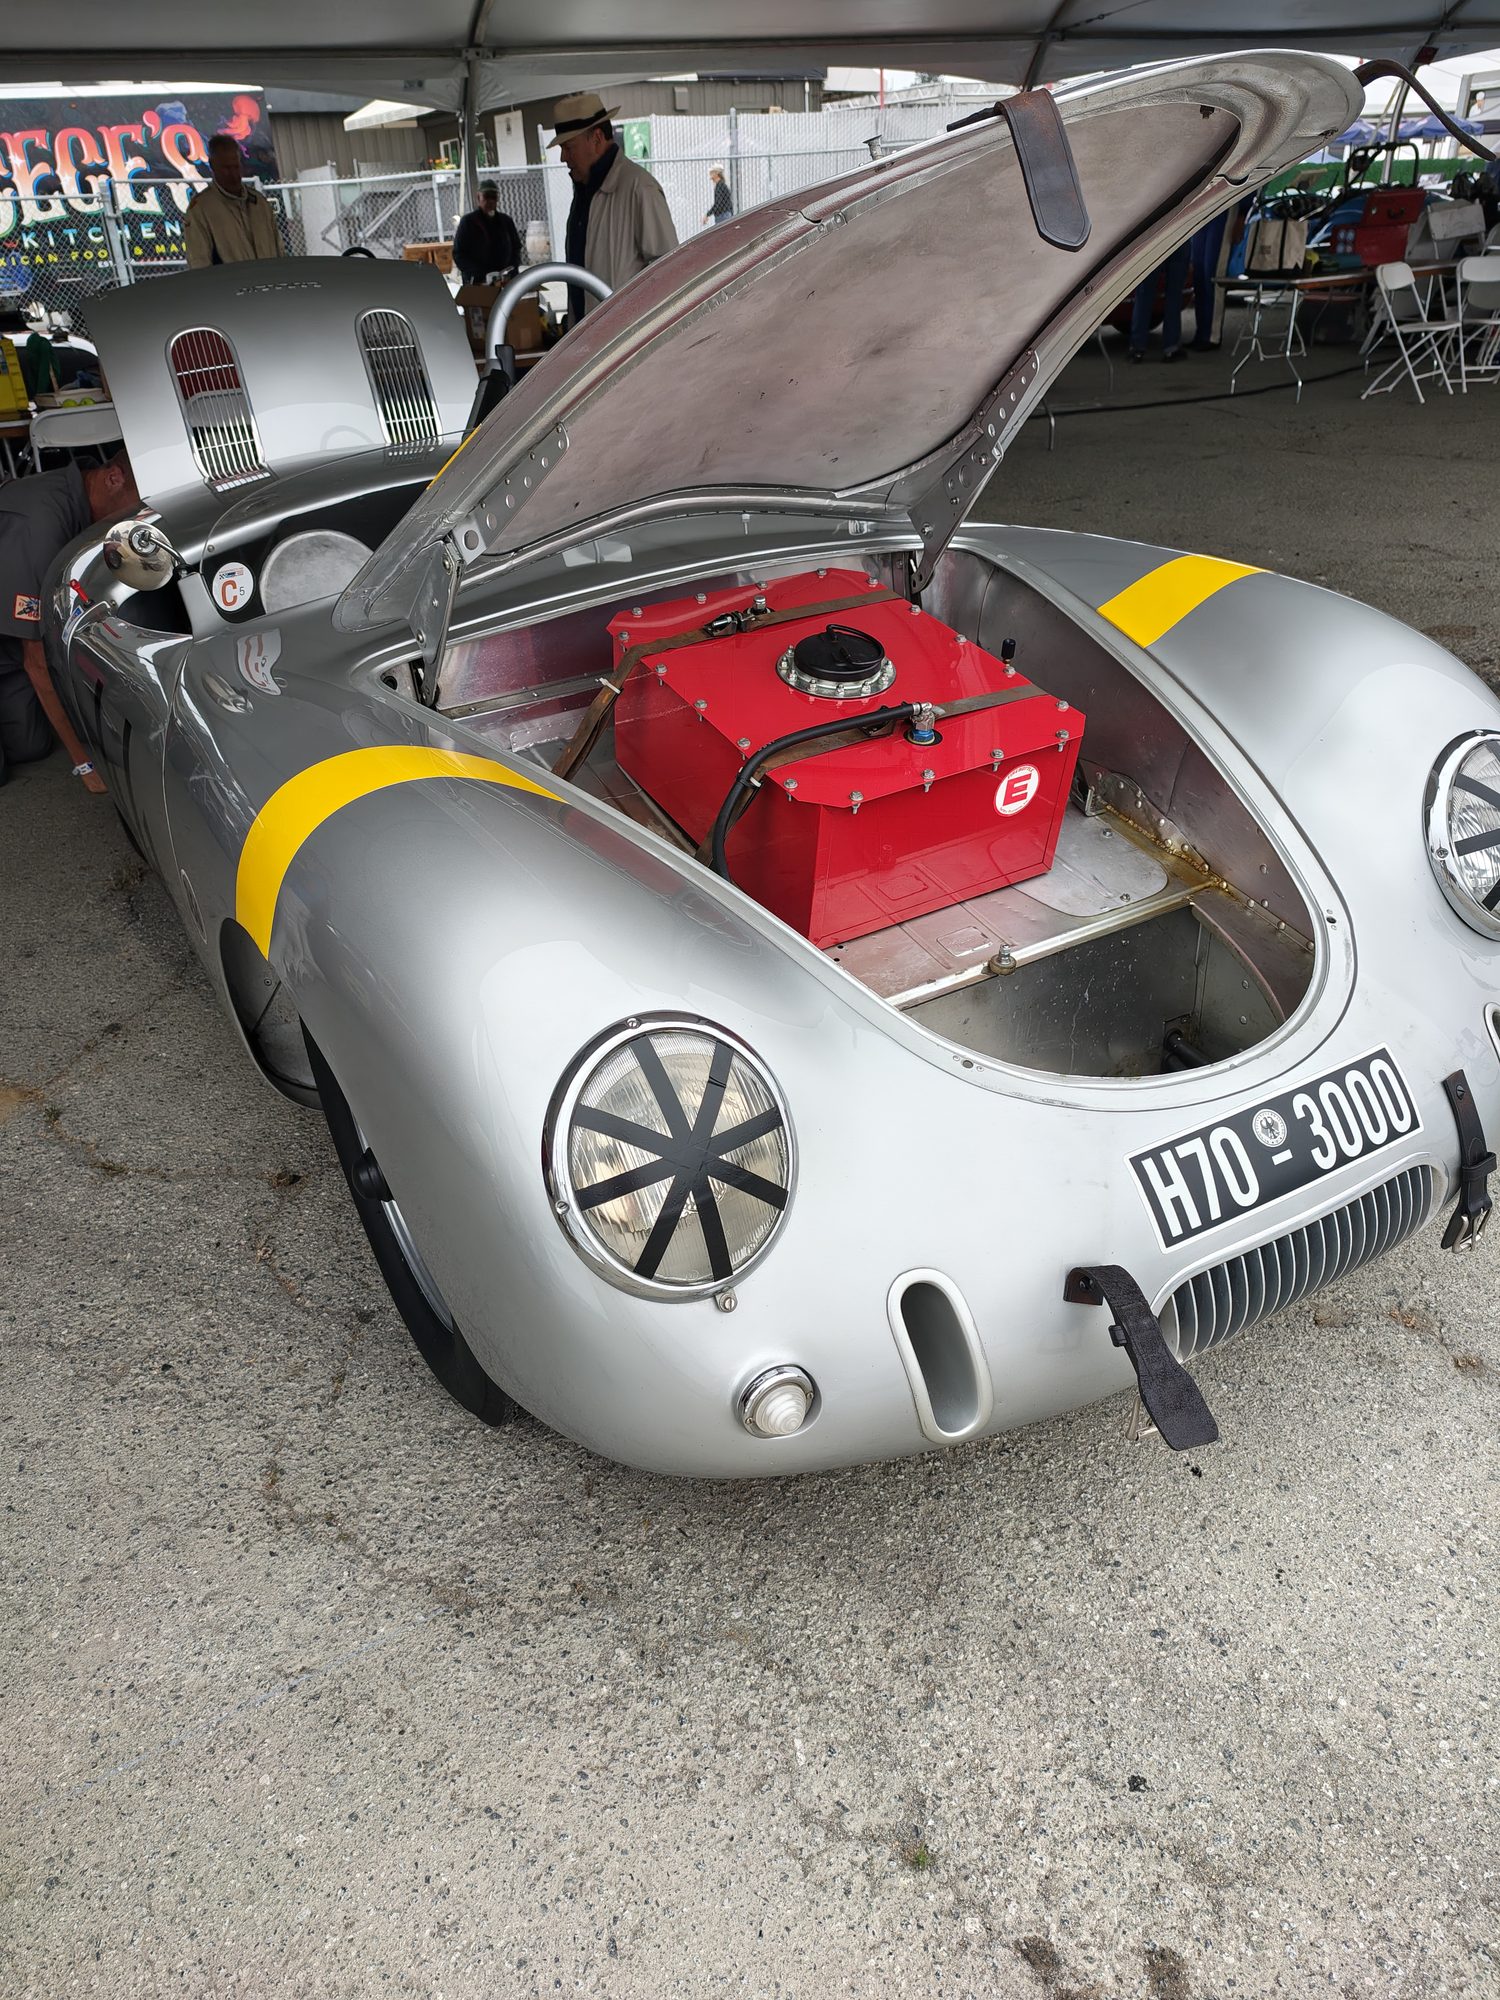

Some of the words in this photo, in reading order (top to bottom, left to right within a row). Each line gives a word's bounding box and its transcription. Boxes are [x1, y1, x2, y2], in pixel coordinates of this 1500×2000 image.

[221, 579, 238, 607] C
[1003, 773, 1032, 806] E
[1141, 1126, 1260, 1238] H70
[1292, 1058, 1412, 1170] 3000
